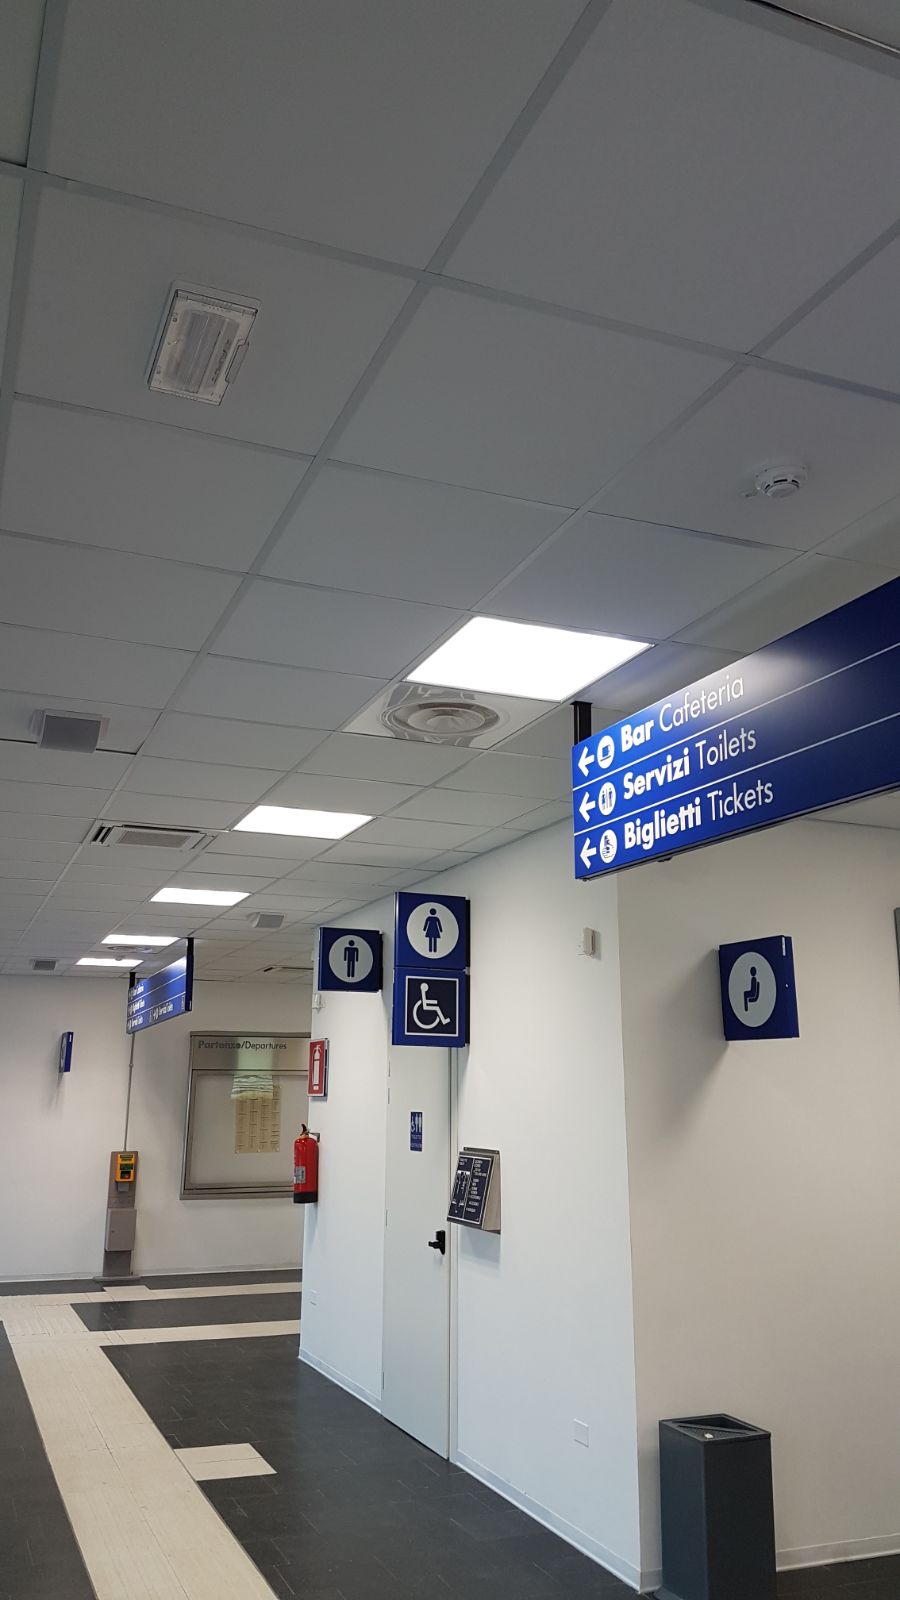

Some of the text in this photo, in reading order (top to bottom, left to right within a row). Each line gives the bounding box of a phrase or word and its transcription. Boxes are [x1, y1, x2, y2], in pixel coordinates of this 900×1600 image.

[621, 674, 744, 752] Bar Cafeteria
[623, 727, 757, 799] Servizi Toilets
[624, 779, 774, 850] Biglietti Tickets
